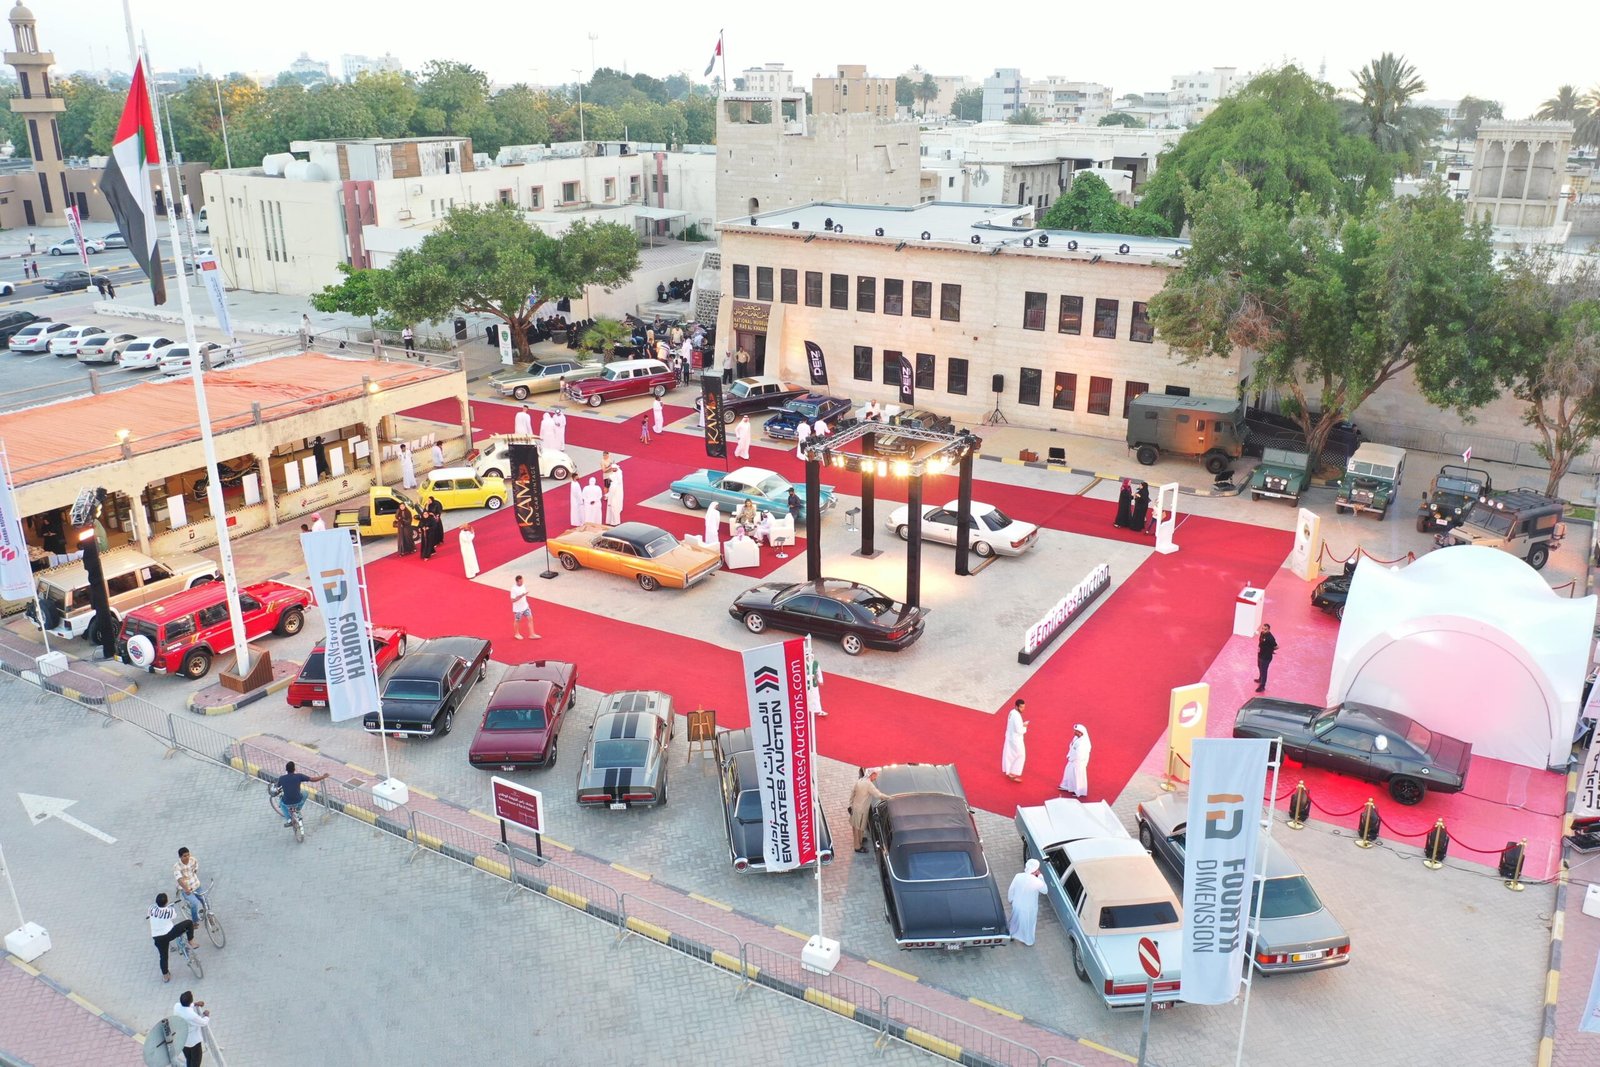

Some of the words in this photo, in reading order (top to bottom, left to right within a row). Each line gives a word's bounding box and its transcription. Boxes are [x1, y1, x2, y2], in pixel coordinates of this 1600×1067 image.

[338, 612, 366, 681] FOURTH
[1029, 564, 1110, 648] #EmiratesAuction
[328, 617, 346, 686] DIMENSION
[771, 699, 786, 778] AUCTION
[790, 658, 812, 855] www.EmiratesAuctions.com
[776, 778, 793, 864] EMIRATES
[1192, 859, 1218, 954] DIMENSION
[1218, 857, 1246, 954] FOURTH
